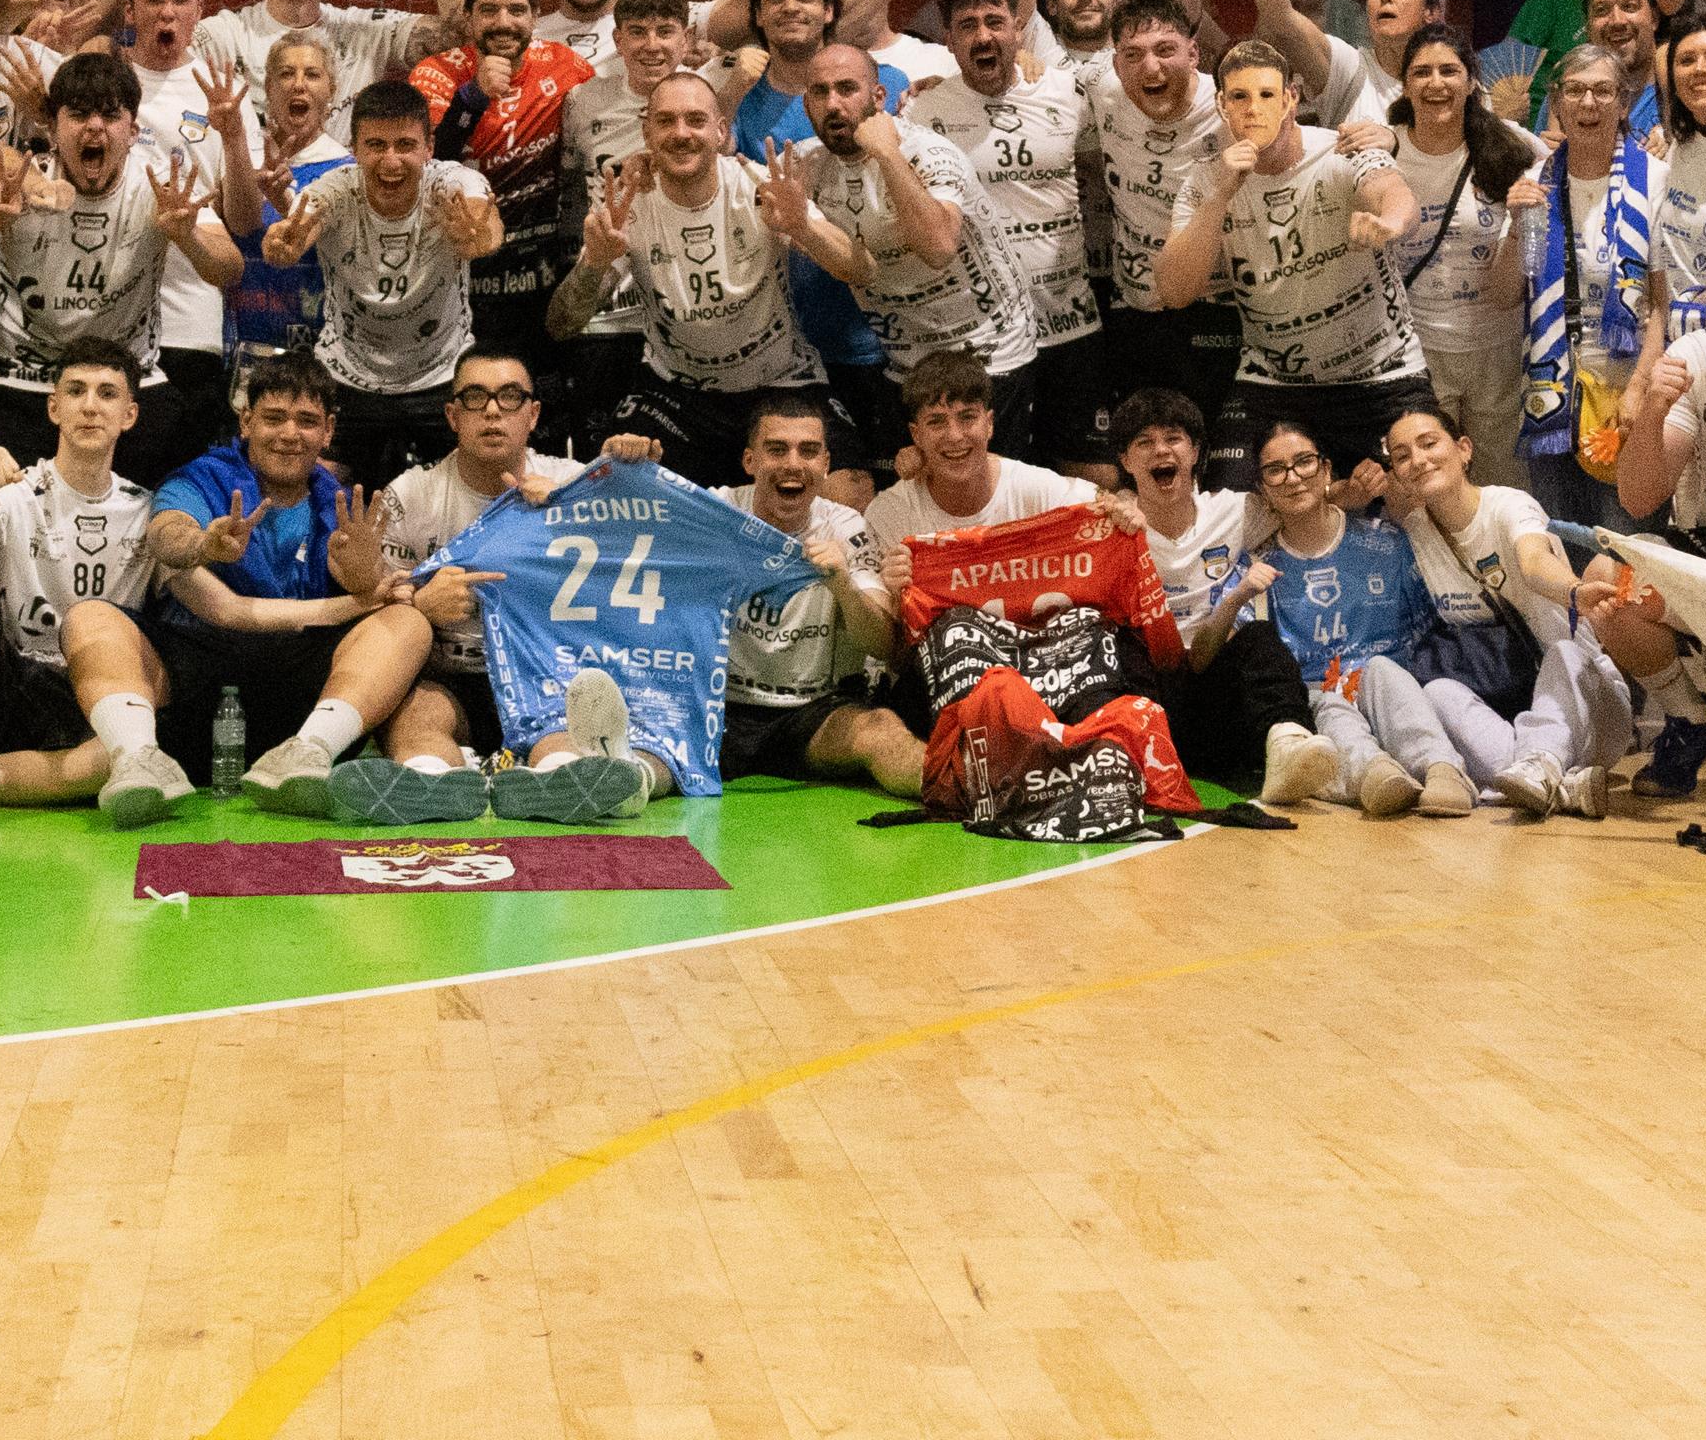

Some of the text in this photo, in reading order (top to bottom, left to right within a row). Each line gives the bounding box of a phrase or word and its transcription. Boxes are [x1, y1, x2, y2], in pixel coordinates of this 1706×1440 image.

[994, 138, 1034, 168] 36
[1148, 161, 1164, 186] 3
[1269, 227, 1304, 264] 13
[67, 259, 107, 295] 44
[378, 274, 408, 302] 99
[688, 270, 725, 305] 95
[544, 498, 670, 527] D.CONDE
[73, 562, 106, 597] 88
[549, 534, 665, 625] 24
[949, 552, 1093, 591] APARICIO
[1313, 610, 1348, 646] 44
[554, 643, 695, 674] SAMSER
